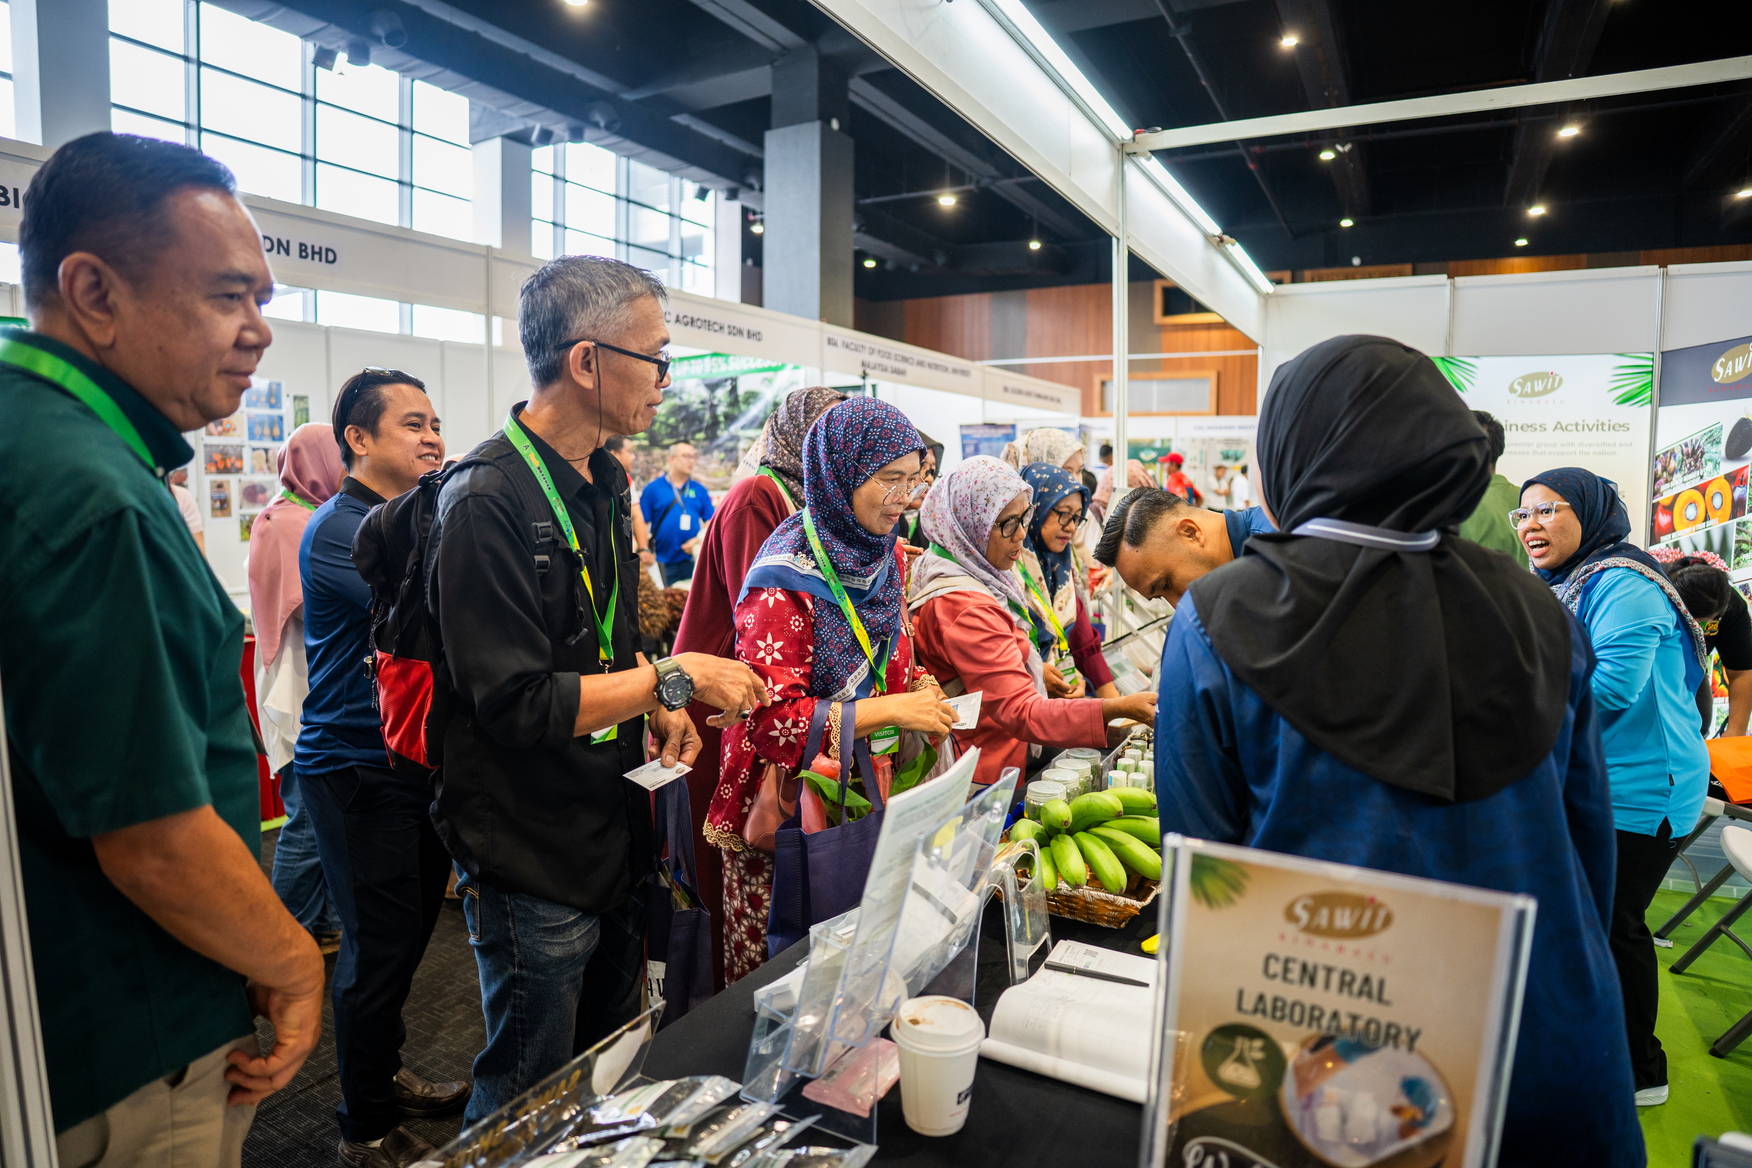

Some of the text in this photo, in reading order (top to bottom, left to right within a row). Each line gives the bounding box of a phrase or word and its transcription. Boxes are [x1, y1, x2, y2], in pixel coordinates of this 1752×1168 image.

[0, 184, 20, 209] BI
[262, 234, 338, 265] DN BHD
[675, 313, 725, 334] AGROTECH
[727, 324, 744, 337] SDN
[747, 329, 763, 342] BHD
[1503, 419, 1630, 432] iness Activities
[1532, 449, 1546, 457] that
[1548, 450, 1577, 458] support
[1579, 449, 1591, 457] the
[1560, 440, 1575, 448] with
[1577, 440, 1617, 448] diversified
[1619, 440, 1633, 448] and
[874, 729, 895, 737] VISITOR
[1262, 952, 1393, 1007] CENTRAL
[1235, 987, 1423, 1053] LABORATORY
